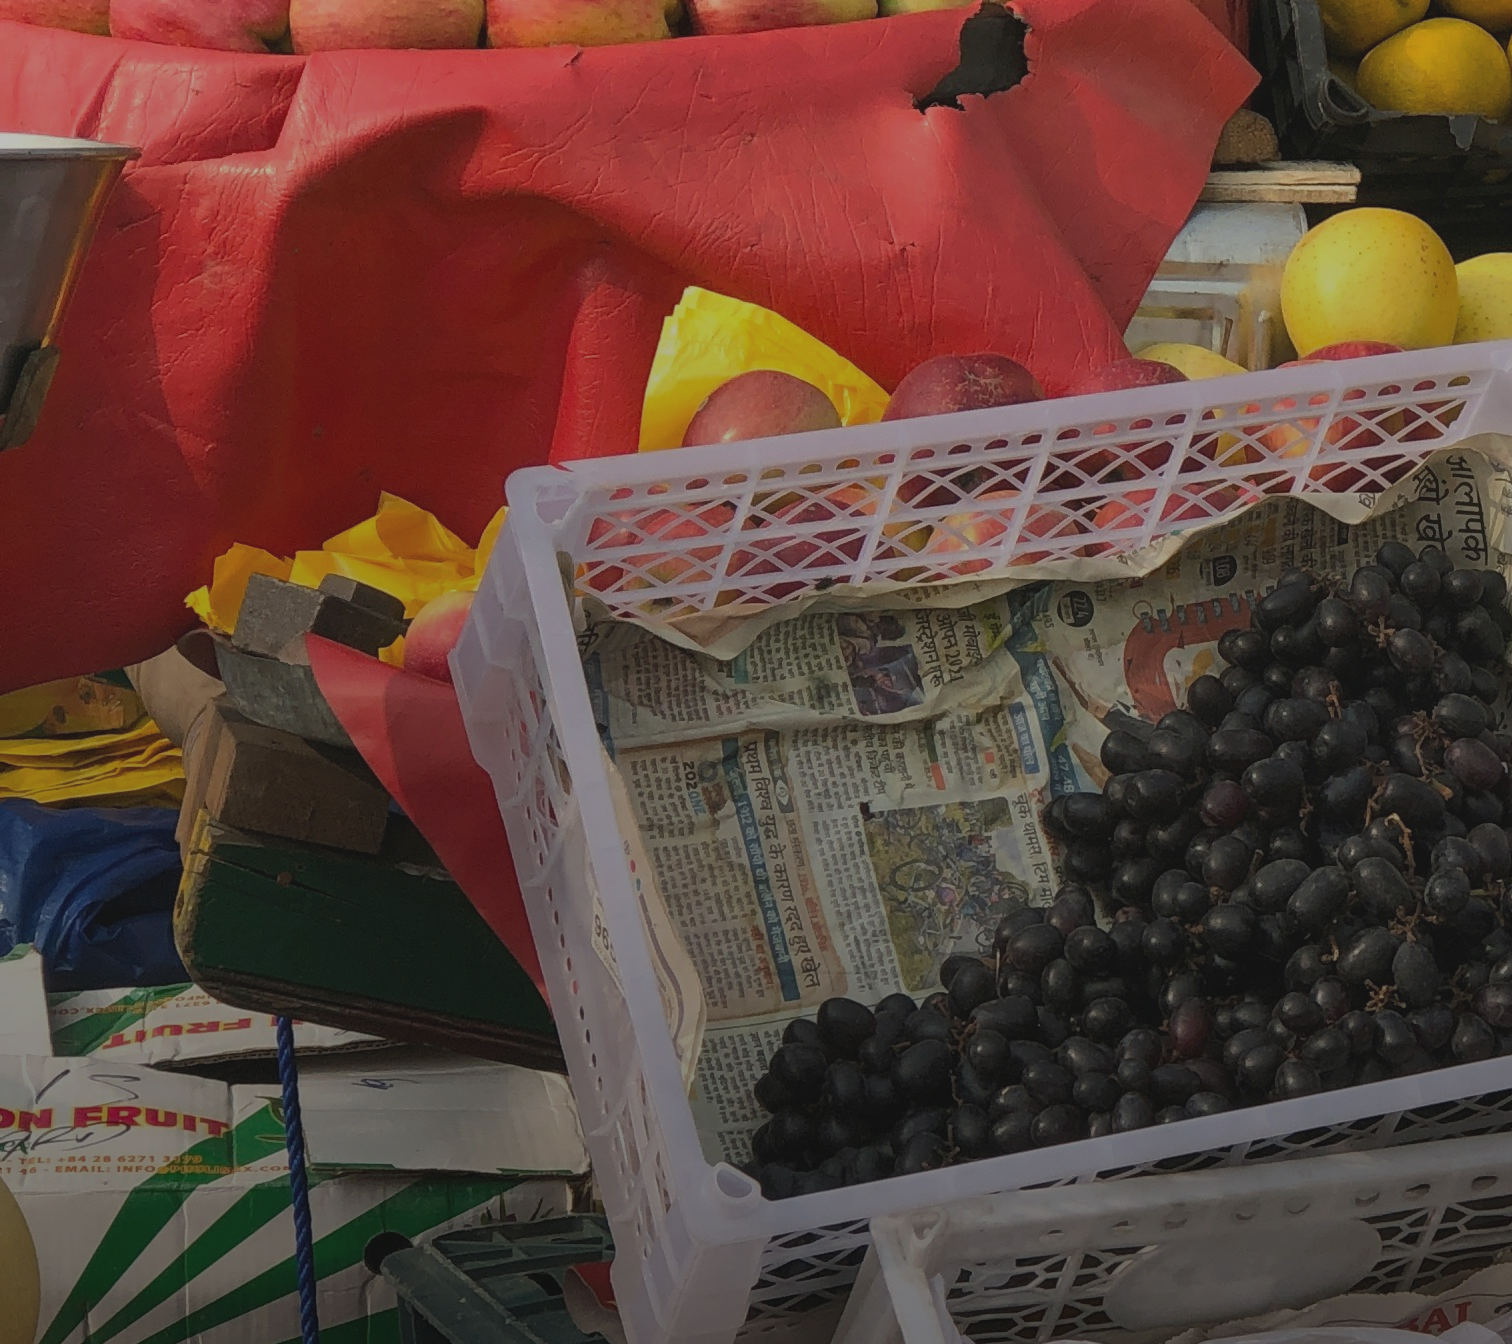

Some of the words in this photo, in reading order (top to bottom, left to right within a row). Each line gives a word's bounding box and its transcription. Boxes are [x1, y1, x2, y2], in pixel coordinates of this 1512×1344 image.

[934, 610, 964, 651] ओपन
[941, 649, 968, 684] 2021
[739, 740, 766, 777] प्रथम
[750, 774, 778, 812] विश्व
[736, 799, 754, 826] 1912
[756, 812, 782, 841] युद्ध
[766, 841, 789, 861] के
[770, 860, 796, 904] कारण
[788, 933, 811, 957] हुए
[797, 954, 827, 990] खेल
[103, 1016, 252, 1050] FRUIT
[72, 1105, 230, 1137] FRUIT
[55, 1165, 111, 1173] EMAIL:
